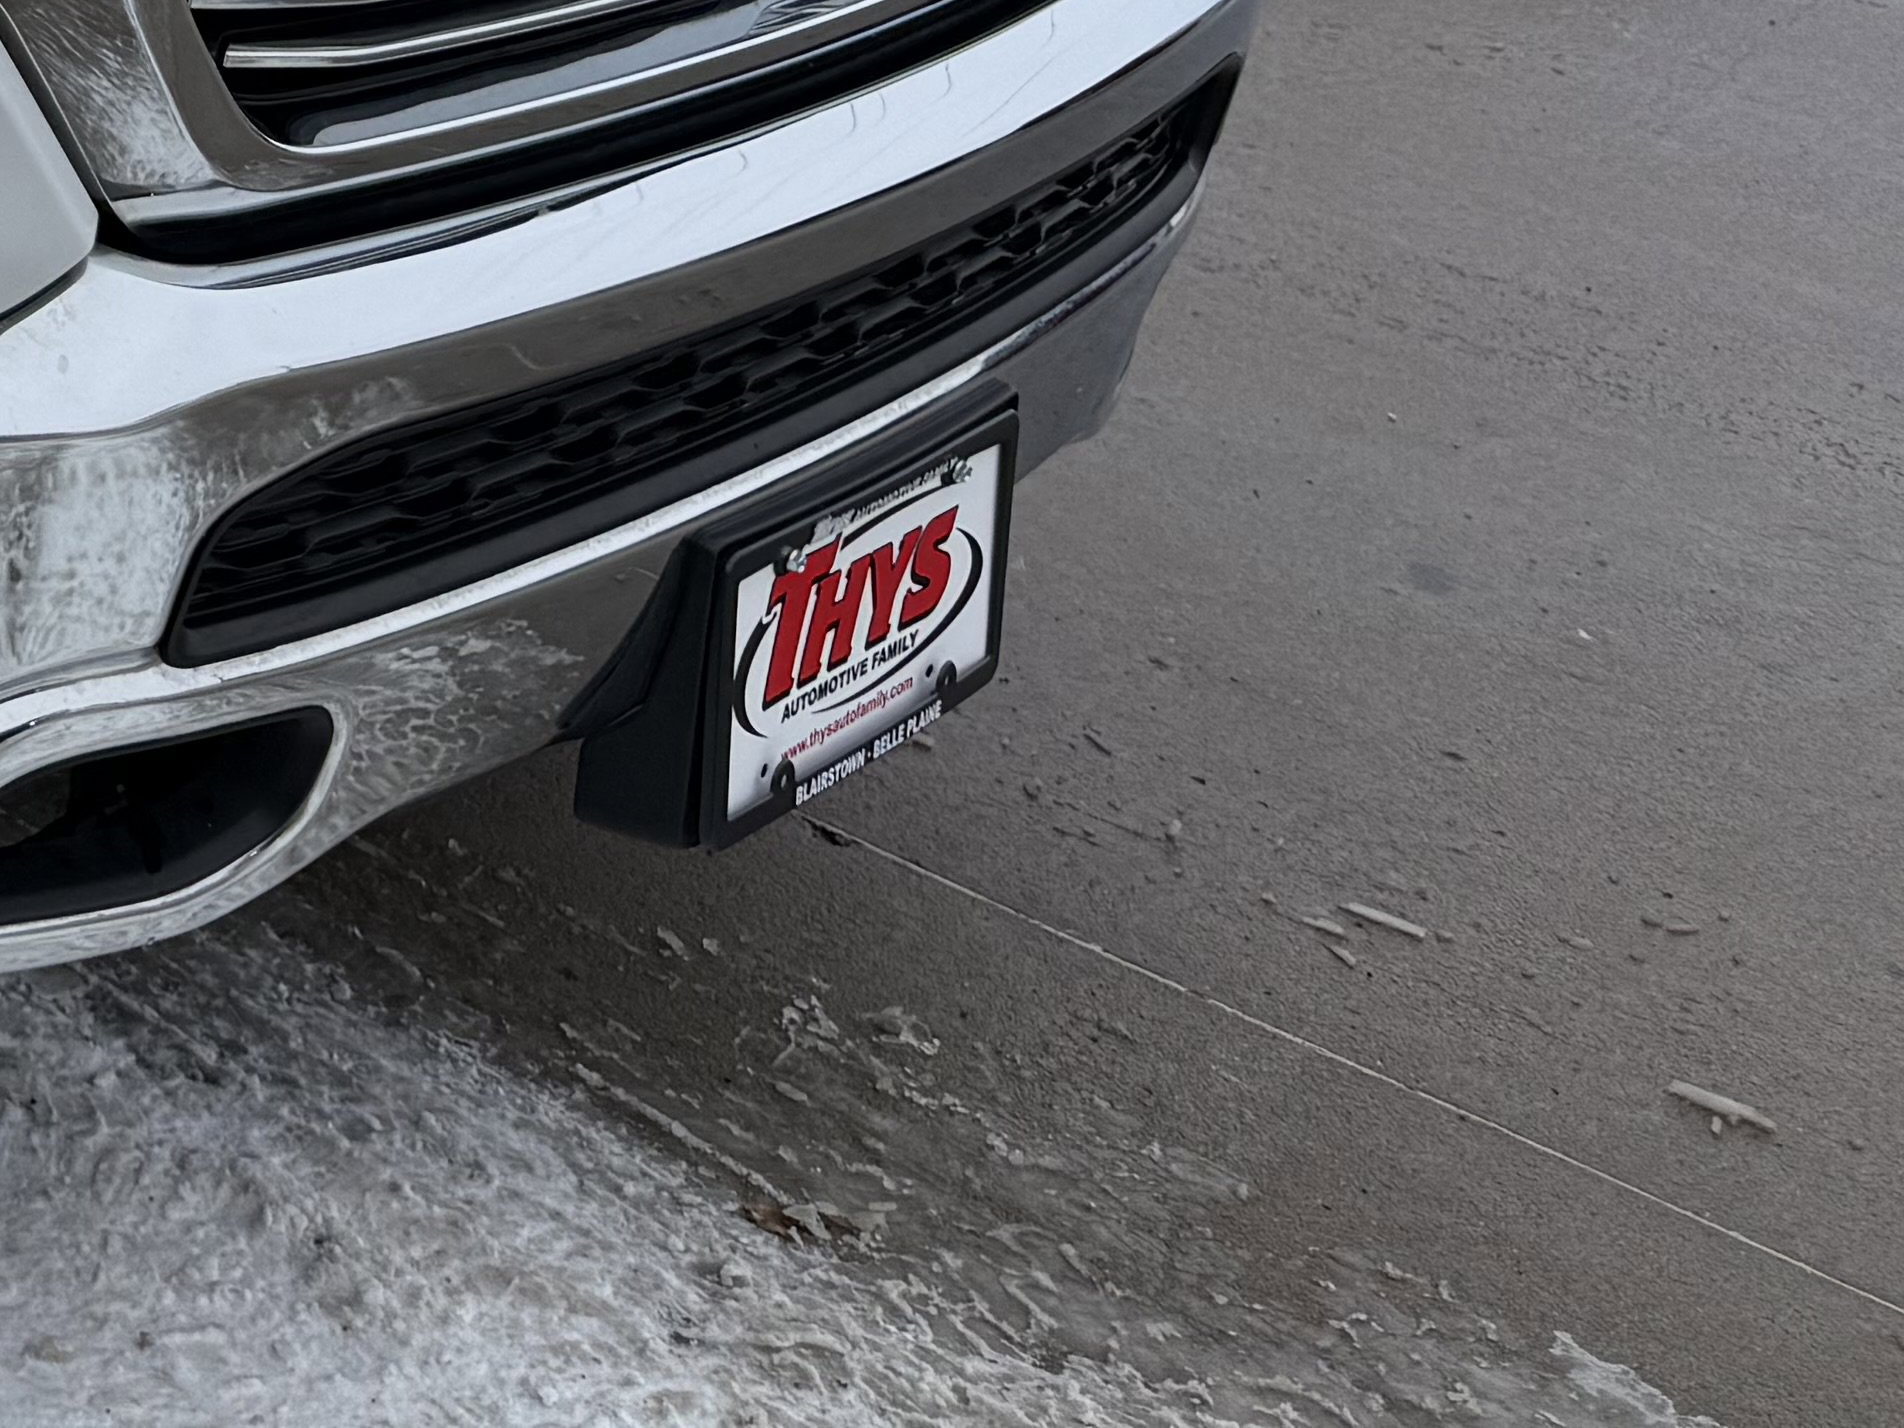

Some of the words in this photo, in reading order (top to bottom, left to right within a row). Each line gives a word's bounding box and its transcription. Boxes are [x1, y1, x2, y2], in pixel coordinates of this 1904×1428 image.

[762, 505, 959, 712] THYS
[780, 676, 914, 761] www.thysautofamily.com
[781, 657, 869, 724] AUTOMOTIVE
[871, 629, 919, 671] FAMILY
[795, 747, 866, 806] BLAIRSTOWN
[872, 722, 906, 760] BELLE
[906, 699, 942, 738] PLAINE
